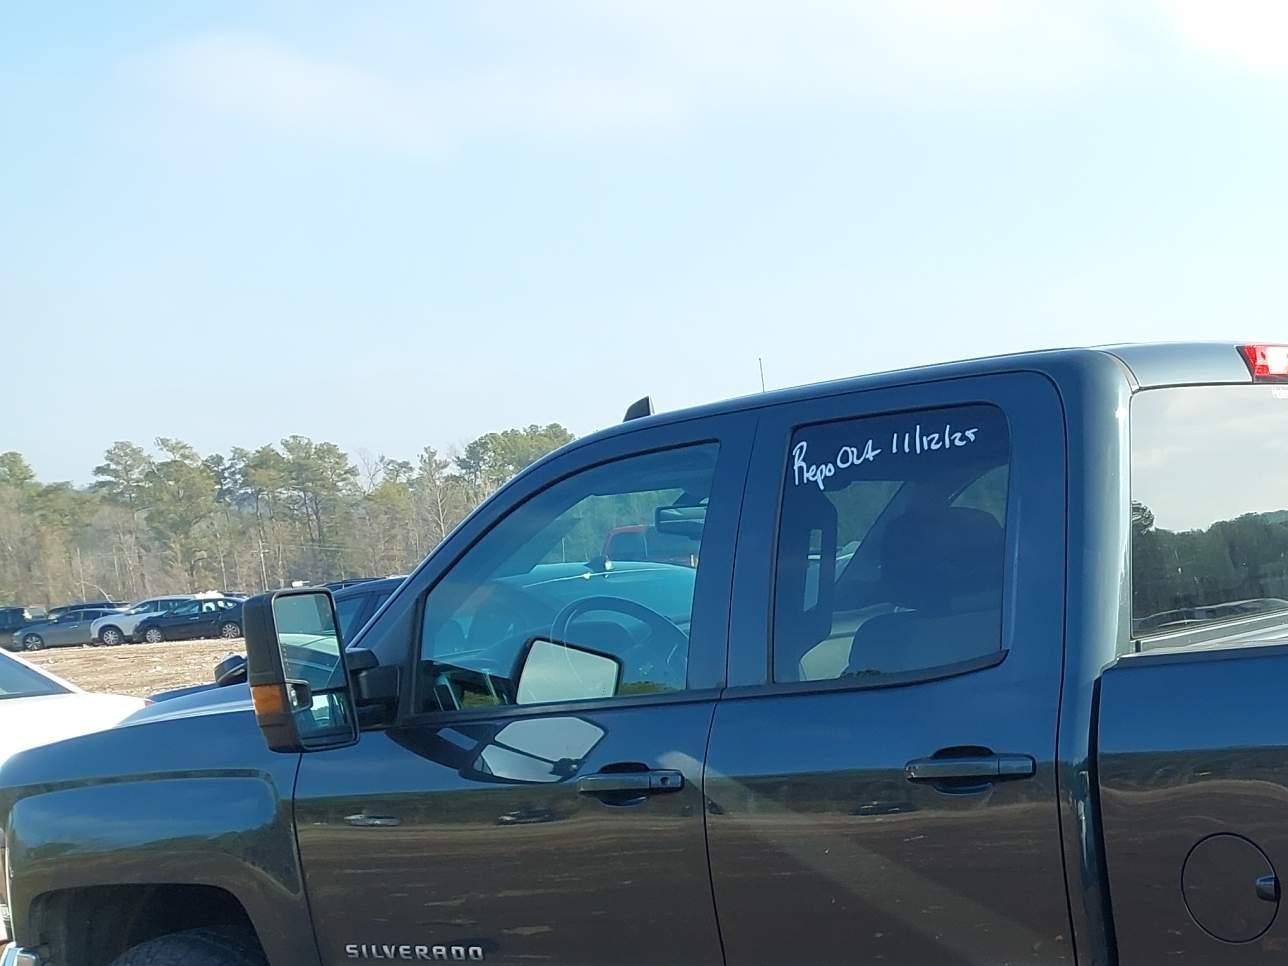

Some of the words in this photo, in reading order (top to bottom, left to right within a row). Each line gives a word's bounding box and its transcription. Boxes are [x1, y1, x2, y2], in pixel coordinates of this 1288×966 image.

[792, 441, 835, 490] Repo
[892, 425, 979, 454] 11/12/25
[345, 944, 485, 961] SILVERADO
